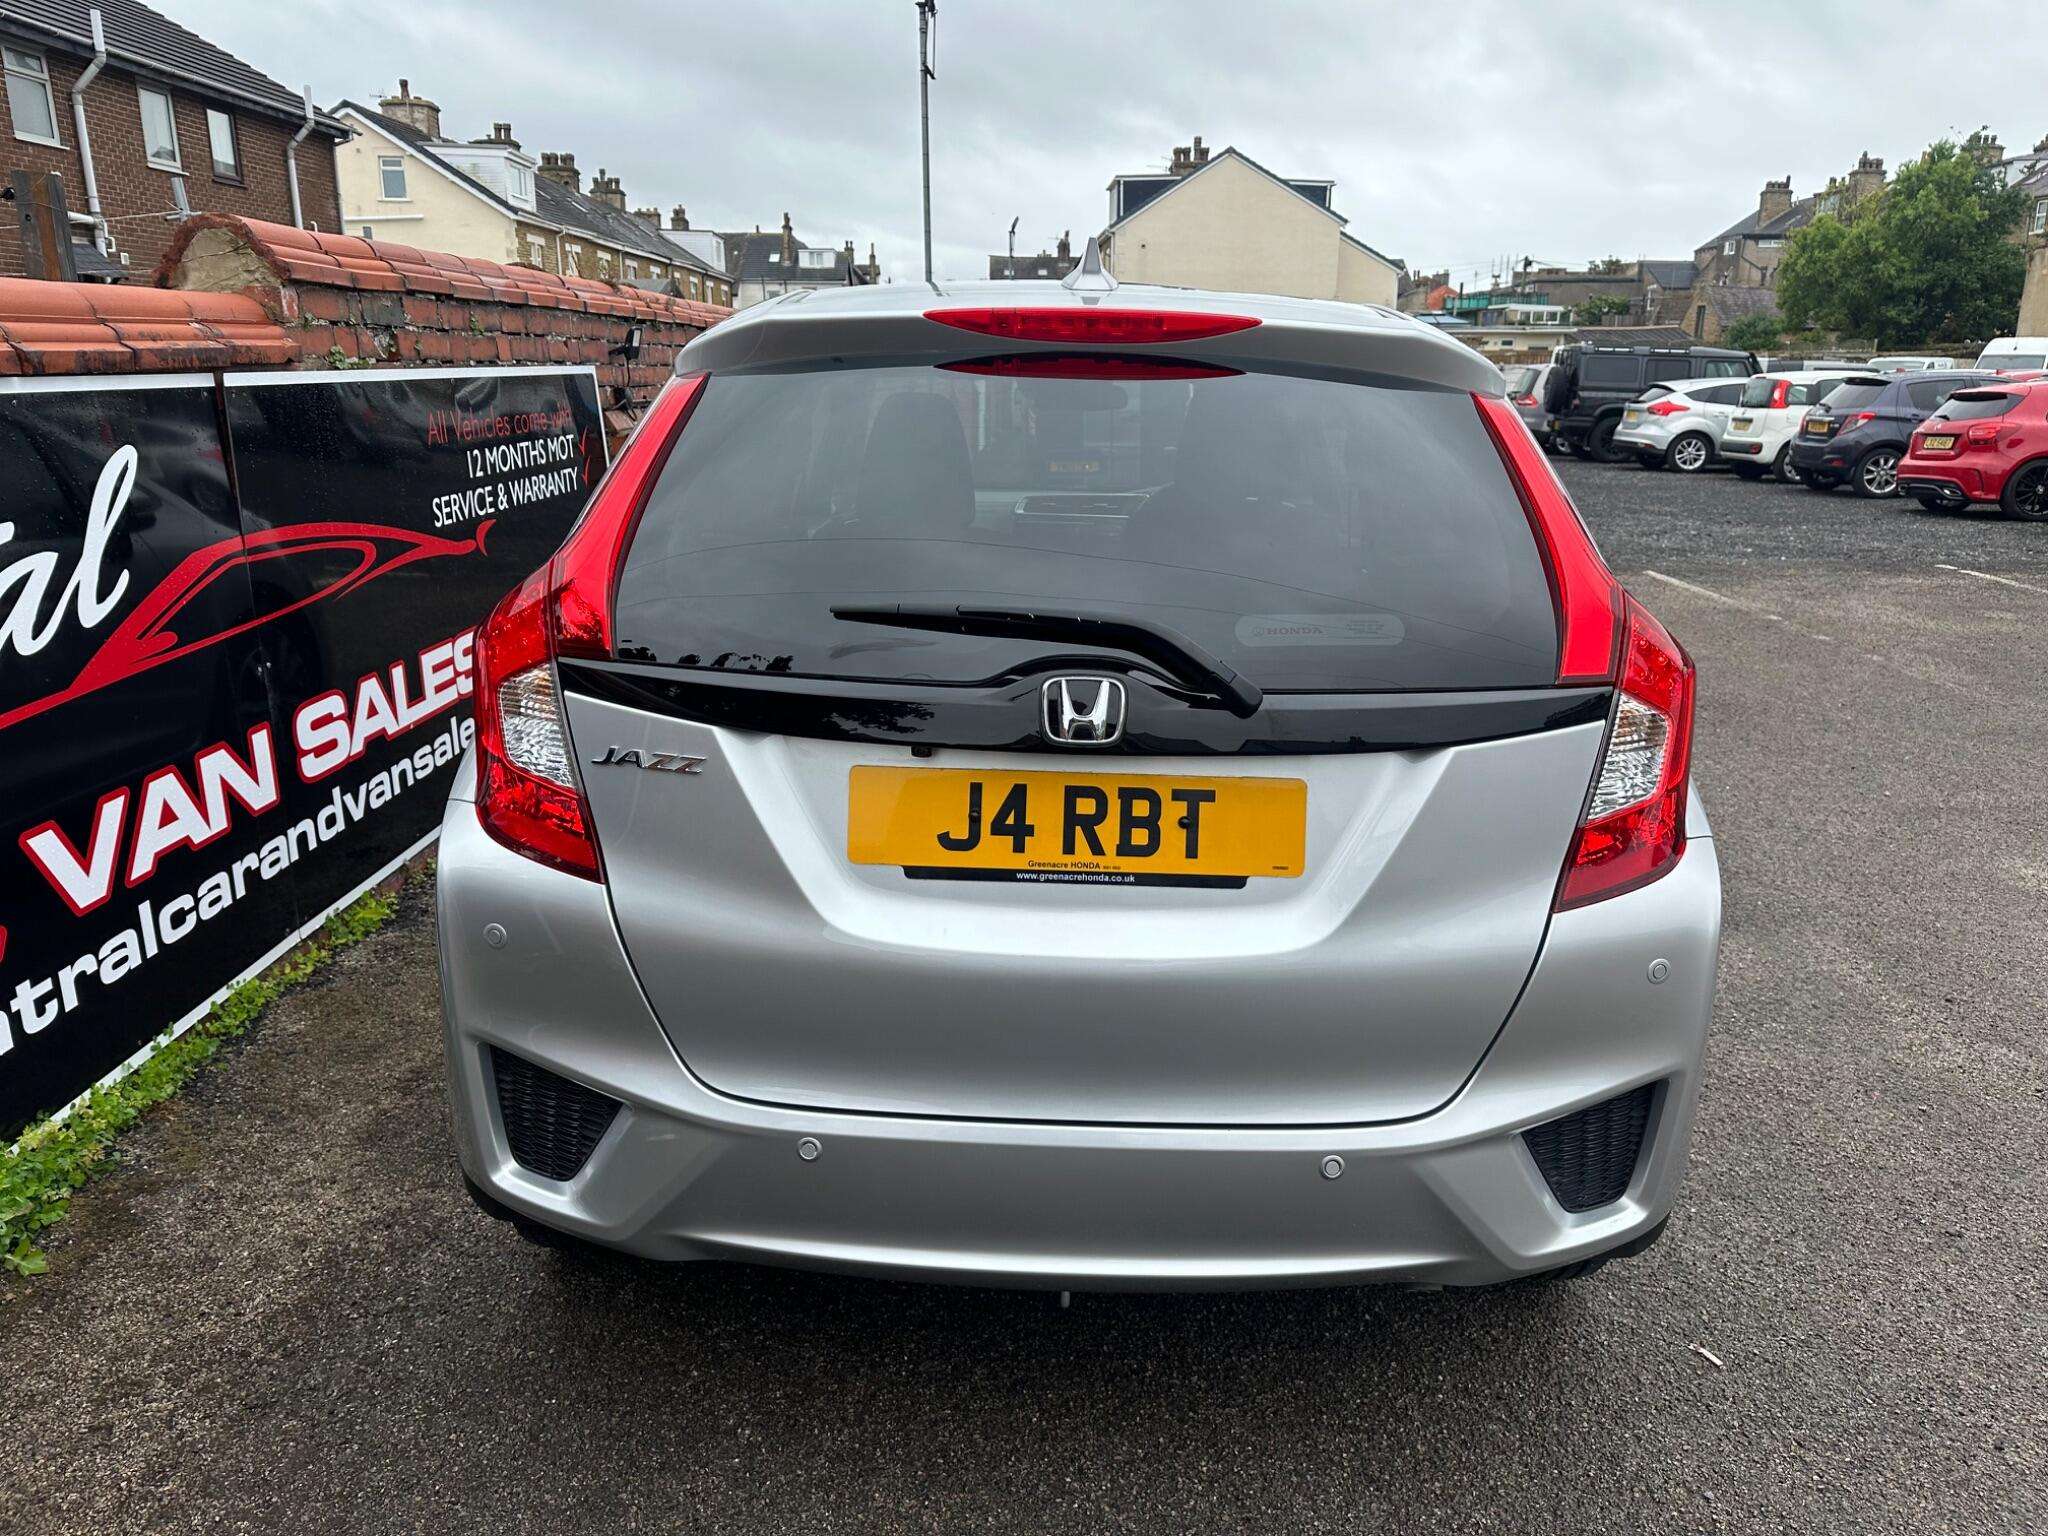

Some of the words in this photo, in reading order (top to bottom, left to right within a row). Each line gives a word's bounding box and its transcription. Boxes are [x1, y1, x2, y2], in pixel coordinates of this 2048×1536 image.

[427, 408, 449, 446] All
[450, 405, 511, 443] Vehicles
[514, 411, 548, 434] come
[550, 402, 574, 430] with
[466, 448, 484, 478] 12
[485, 438, 547, 475] MONTHS
[549, 434, 575, 463] MOT
[432, 485, 496, 528] SERVICE
[497, 483, 510, 511] &
[509, 466, 578, 507] WARRANTY
[0, 444, 138, 656] al
[1266, 625, 1324, 635] HONDA
[591, 745, 707, 774] JAZZ
[20, 722, 279, 917] VAN
[936, 782, 1035, 854] J4
[1062, 784, 1216, 860] RBT
[1016, 871, 1135, 883] www.greenacrehonda.co.uk
[1028, 859, 1069, 869] Greenacre
[1070, 861, 1101, 870] HONDA
